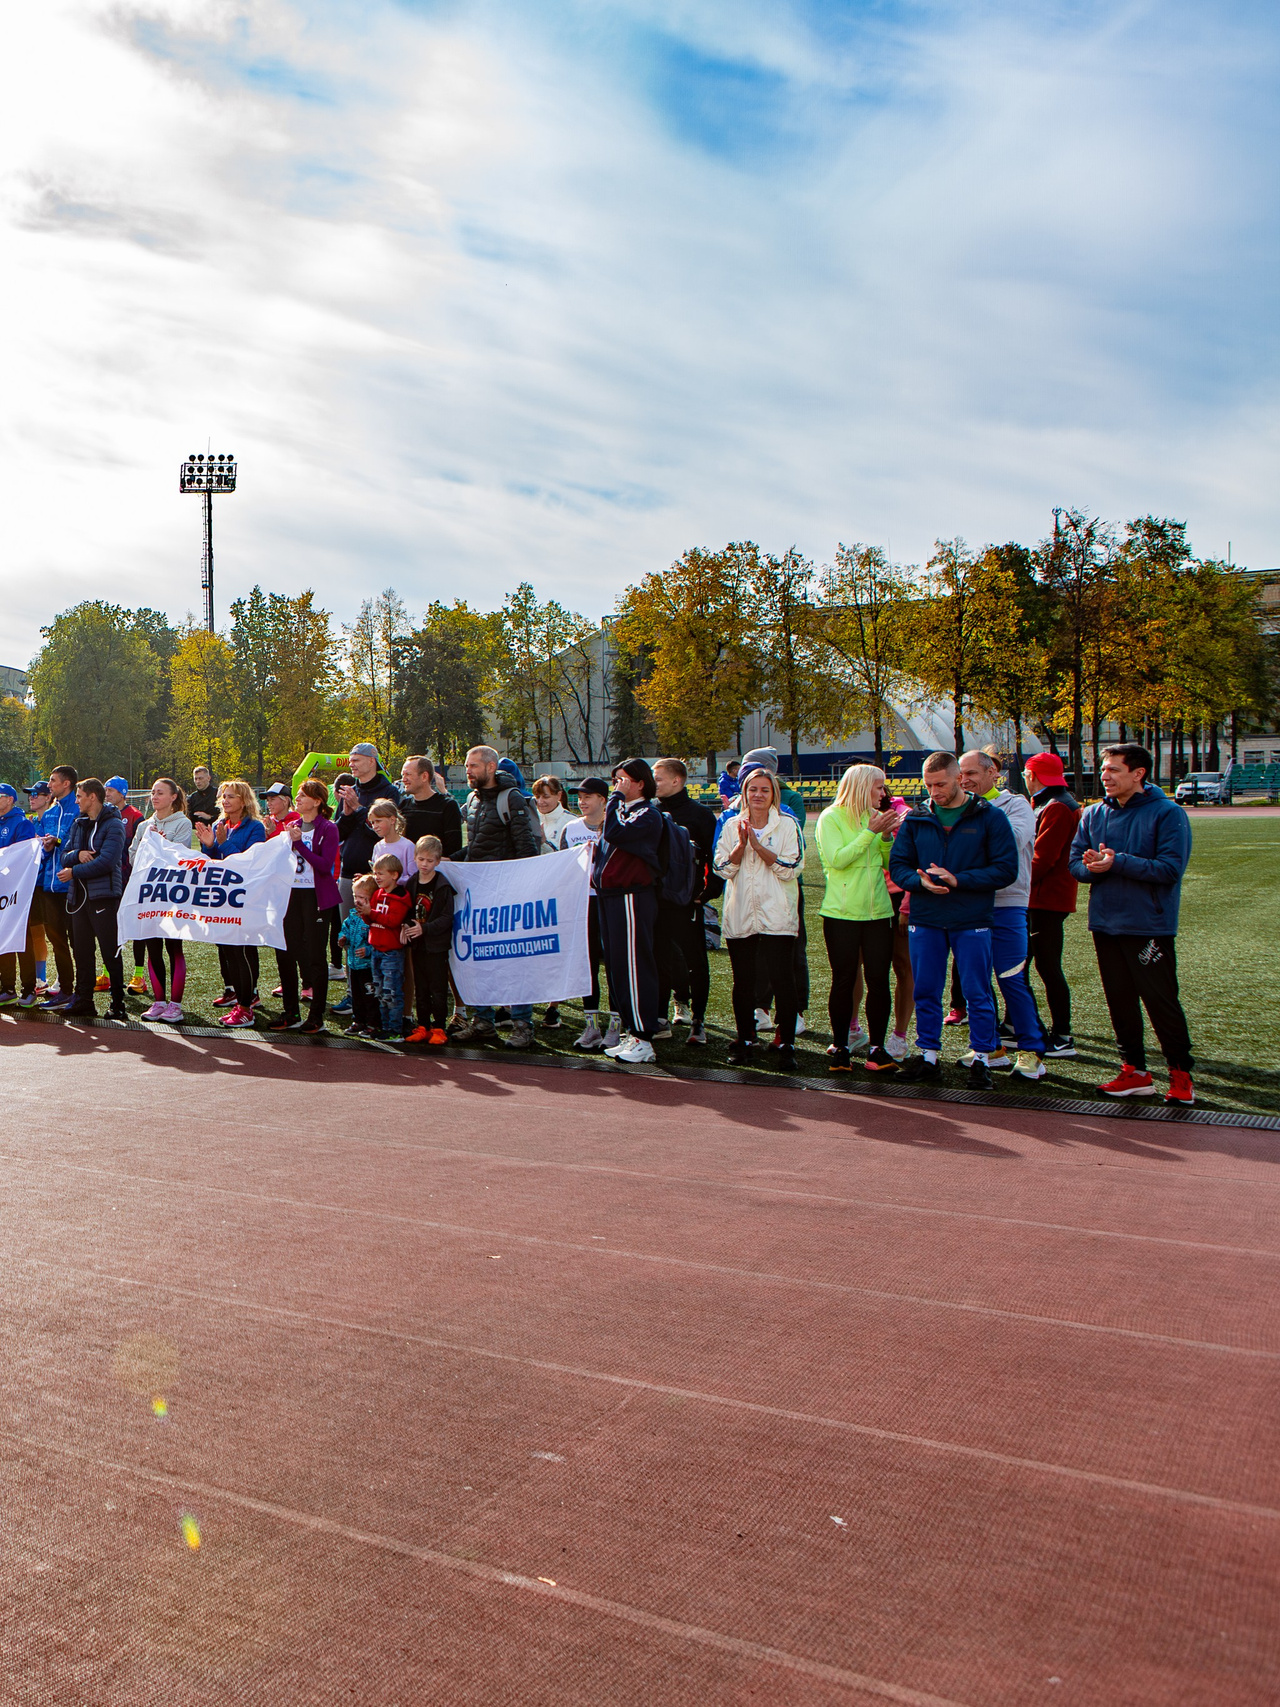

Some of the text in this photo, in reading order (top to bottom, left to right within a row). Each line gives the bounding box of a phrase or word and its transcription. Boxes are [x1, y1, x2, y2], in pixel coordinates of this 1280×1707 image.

[146, 867, 244, 886] ИНТЕР
[138, 883, 247, 908] РАО ЕЭС
[137, 910, 242, 926] энергия без границ
[472, 898, 558, 935] ГАЗПРОМ
[474, 938, 556, 958] ЭНЕРГОХОЛДИНГ
